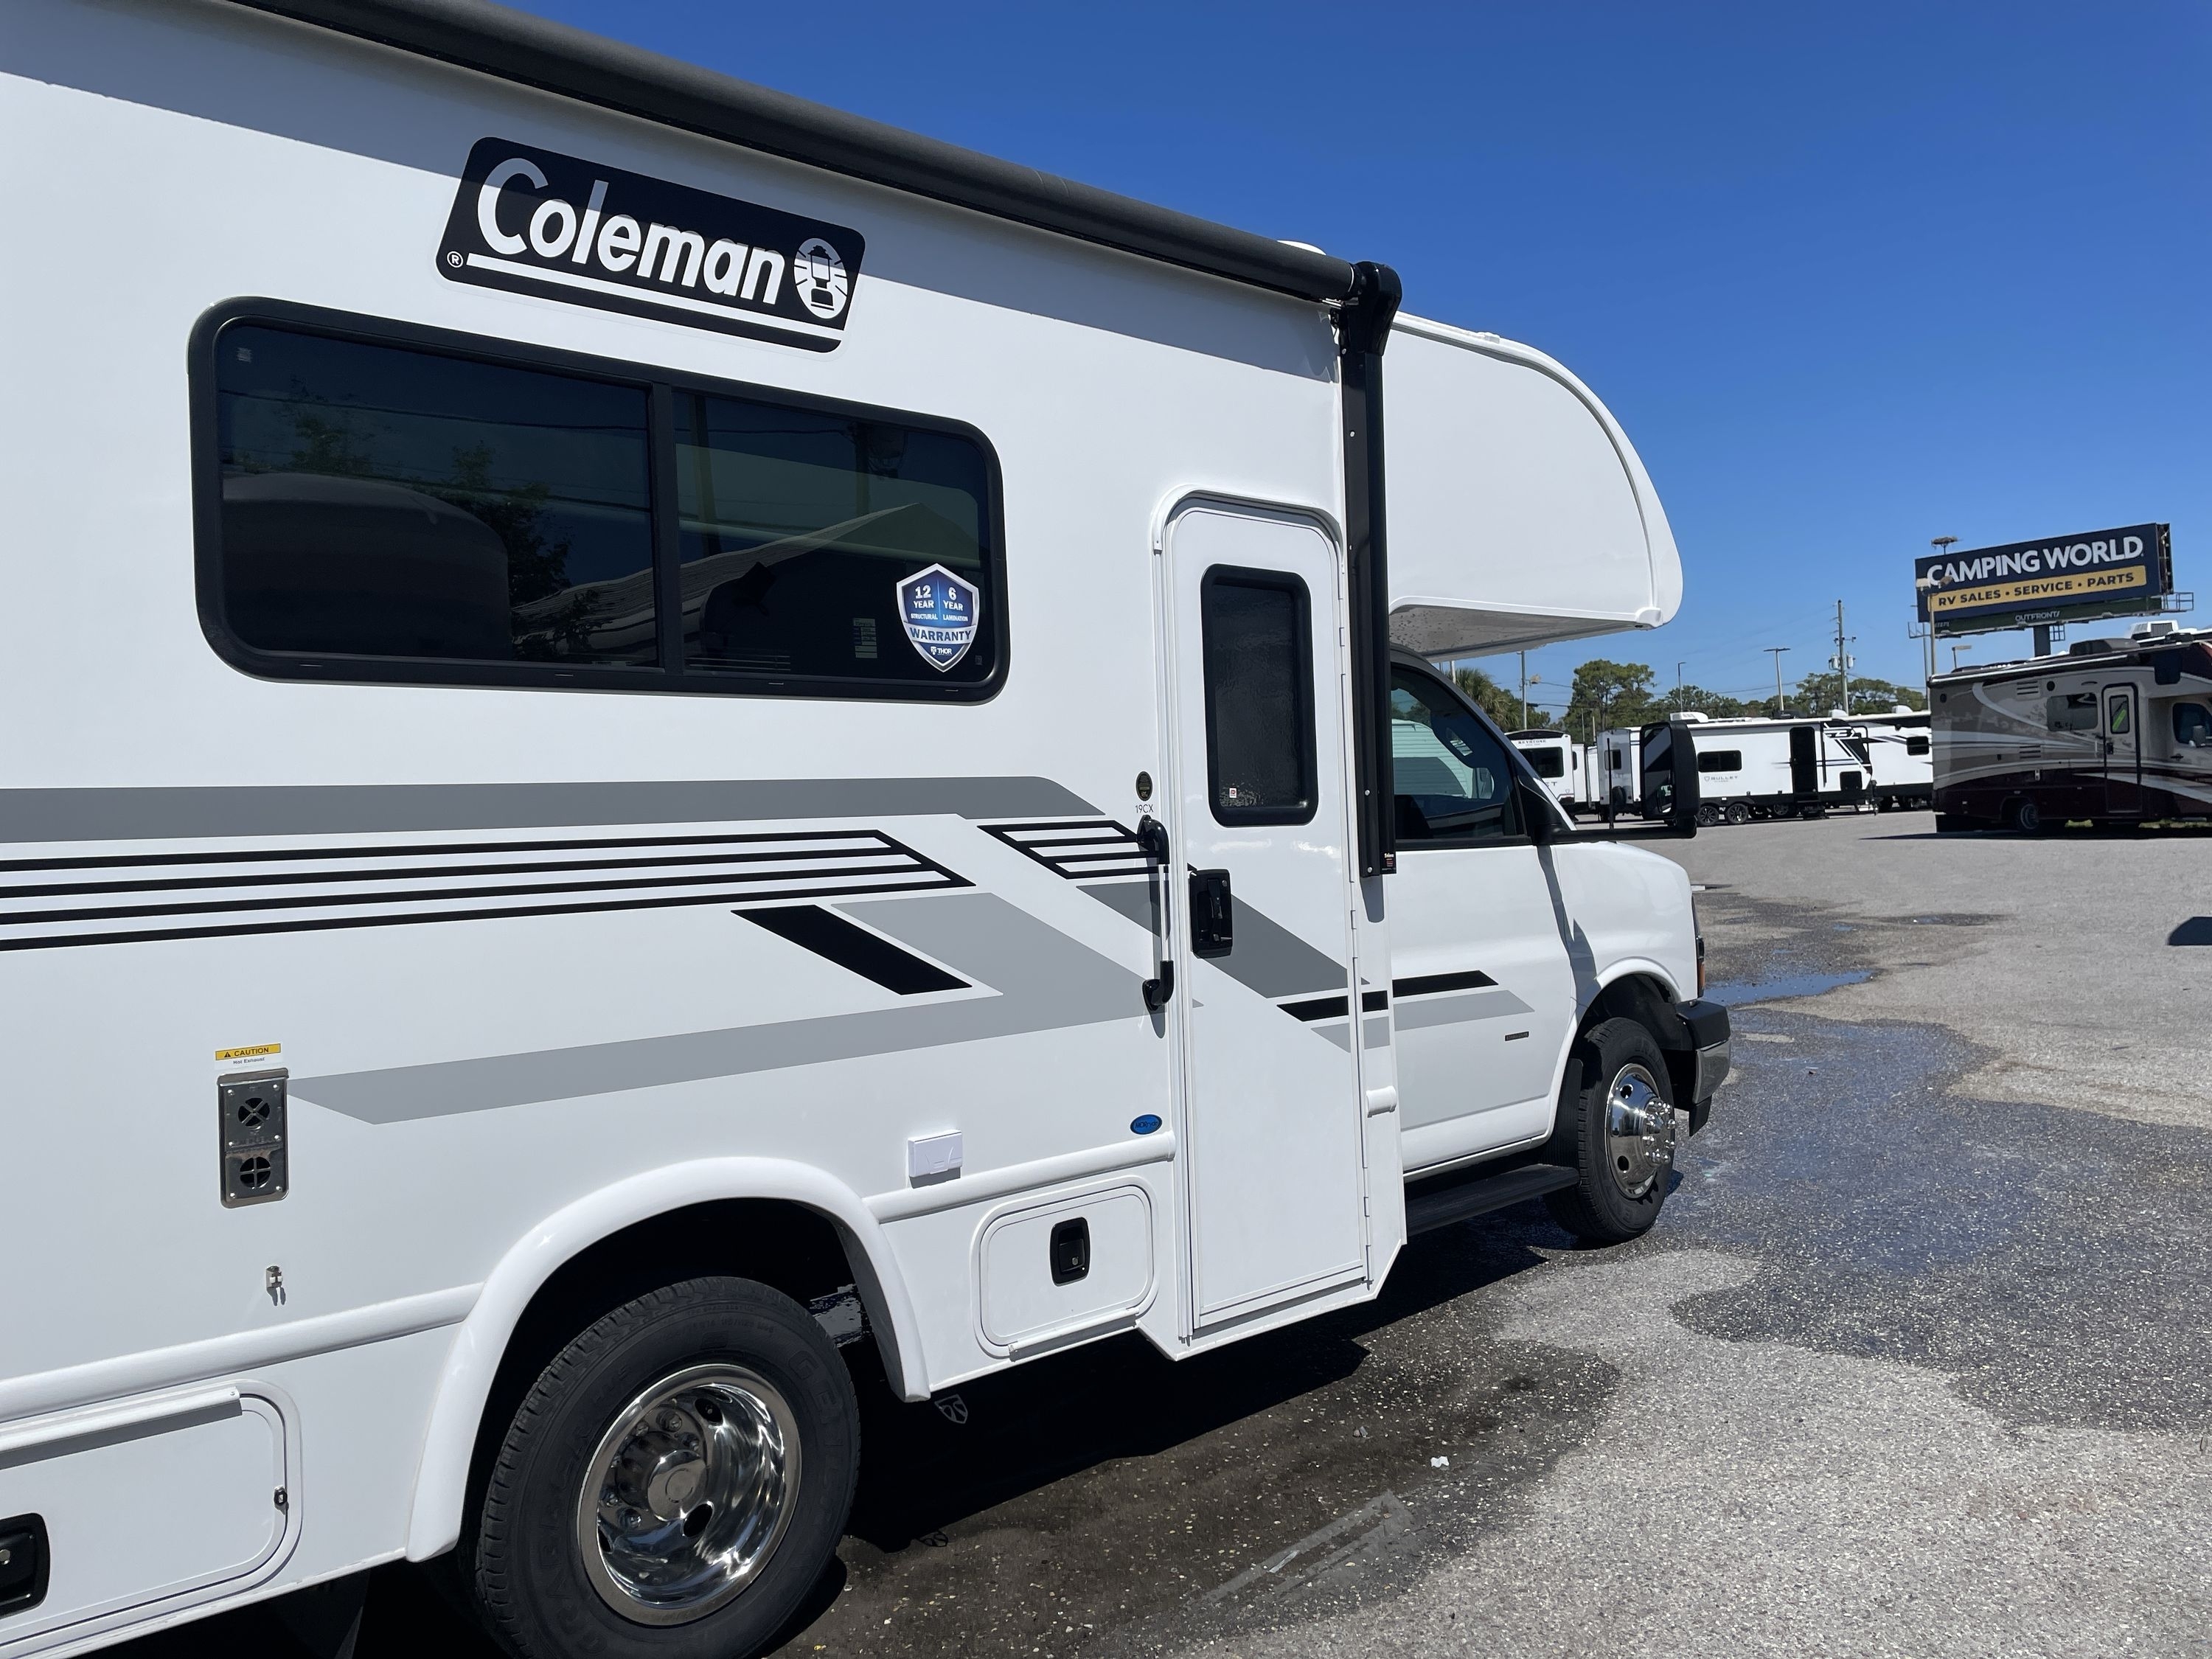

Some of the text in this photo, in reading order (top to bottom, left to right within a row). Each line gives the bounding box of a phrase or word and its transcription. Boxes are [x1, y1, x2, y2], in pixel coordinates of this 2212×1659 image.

[477, 157, 785, 305] Coleman
[1927, 536, 2143, 586] CAMPING WORLD
[915, 585, 931, 599] 12
[948, 587, 957, 601] 6
[1938, 572, 2135, 607] RV SALES SERVICE PARTS
[913, 600, 934, 608] YEAR
[942, 600, 964, 611] YEAR
[909, 627, 972, 641] WARRANTY
[1135, 804, 1154, 813] 19CX
[234, 1047, 269, 1057] CAUTION
